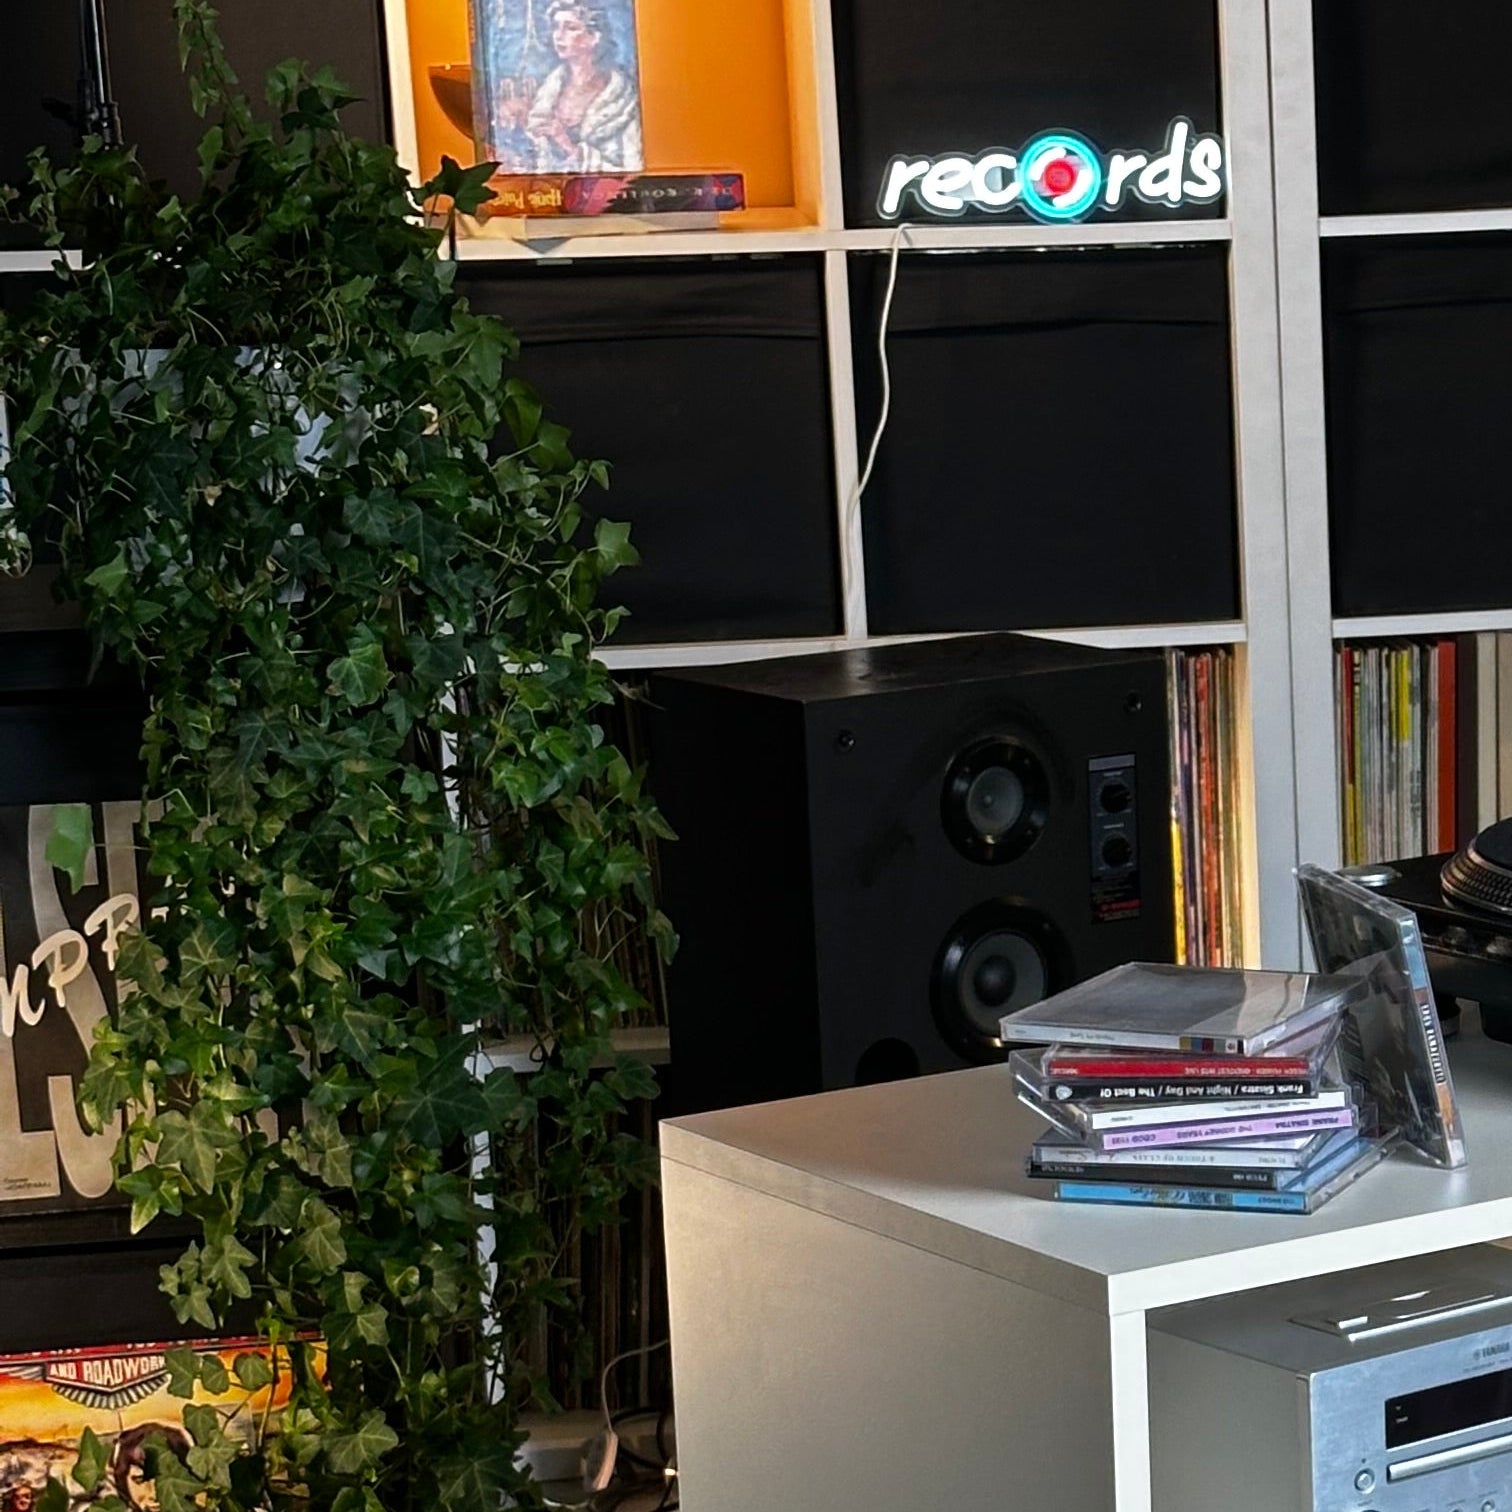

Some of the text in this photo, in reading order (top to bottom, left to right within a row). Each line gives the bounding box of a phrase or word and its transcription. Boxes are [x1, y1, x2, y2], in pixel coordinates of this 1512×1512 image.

[882, 120, 1222, 218] records
[1100, 1087, 1112, 1098] Of
[1138, 1087, 1155, 1098] The
[1165, 1084, 1184, 1097] Day
[1206, 1084, 1232, 1097] Night
[1241, 1084, 1275, 1096] Sinatra
[1276, 1084, 1304, 1095] Frank
[49, 1361, 76, 1380] AND
